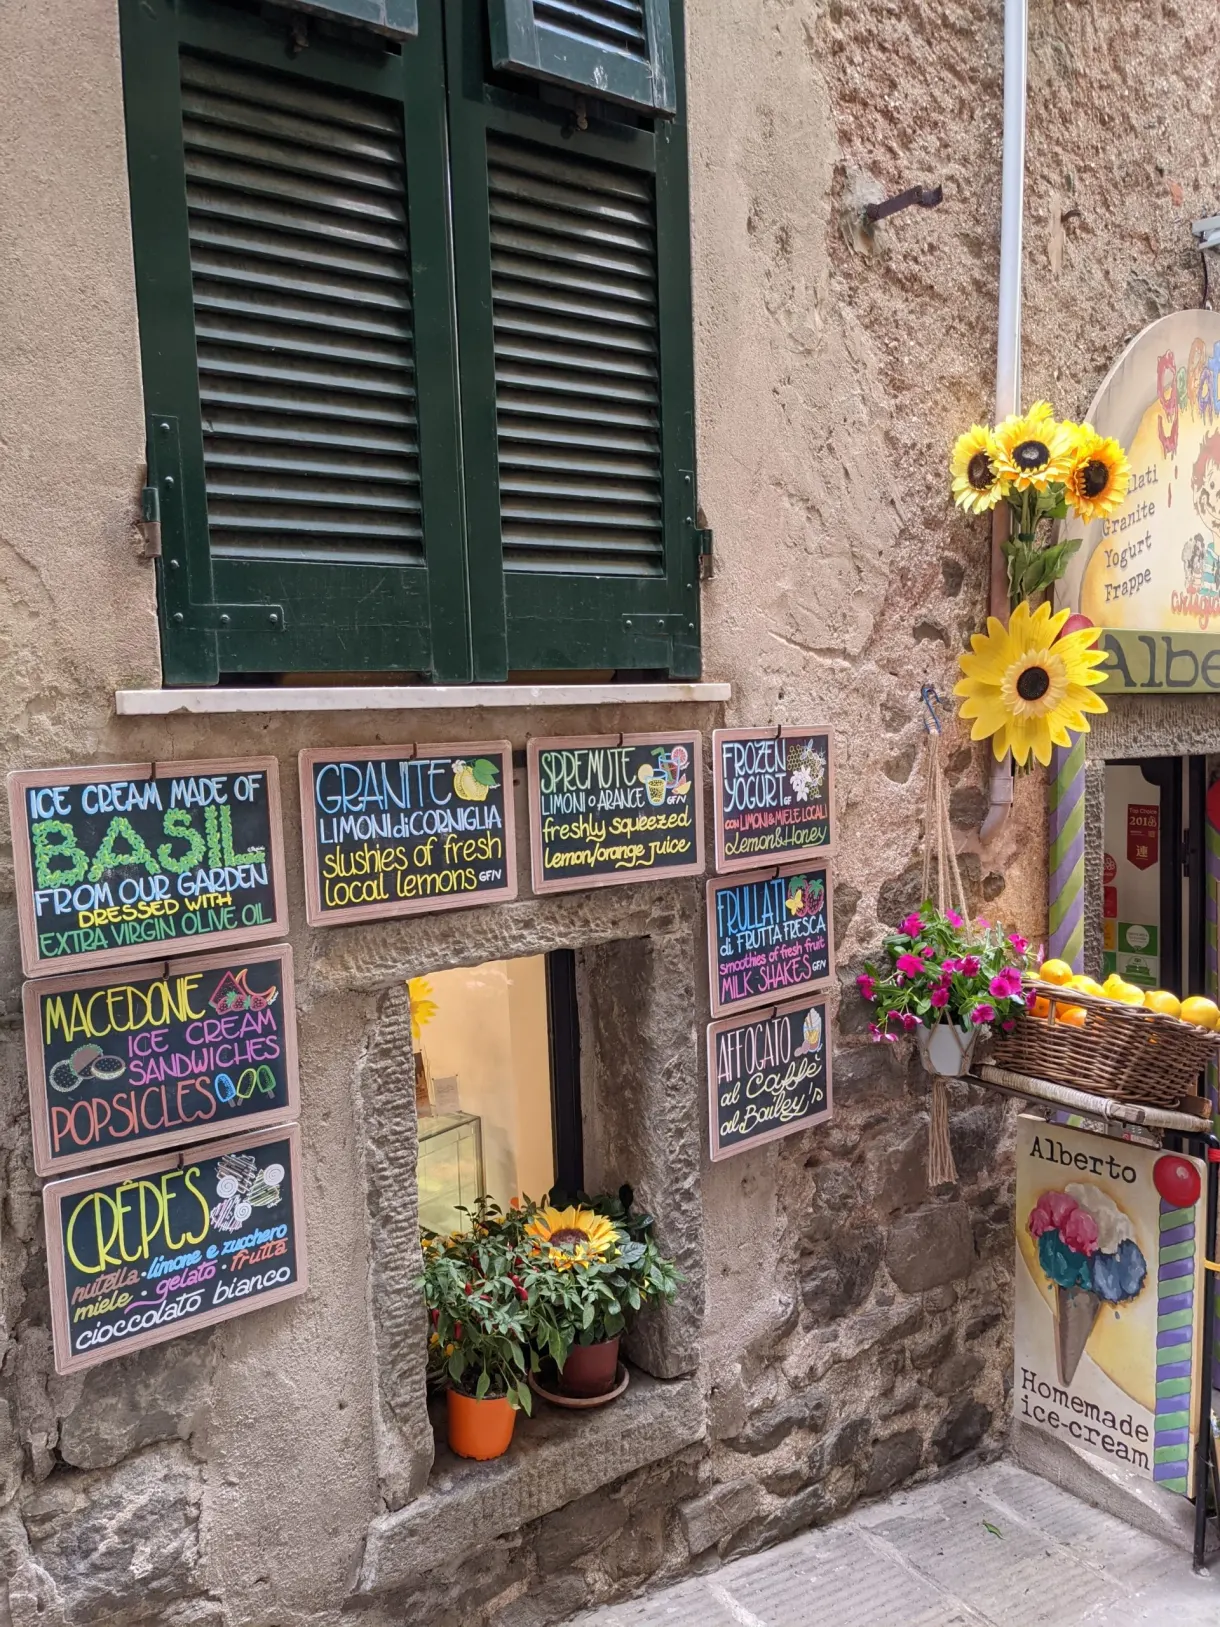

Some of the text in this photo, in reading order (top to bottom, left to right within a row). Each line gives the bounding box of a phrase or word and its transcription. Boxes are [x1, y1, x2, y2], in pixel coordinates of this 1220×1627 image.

[1102, 500, 1155, 536] Granite
[1104, 529, 1152, 569] Yogurt
[1104, 568, 1152, 602] Frappe
[541, 748, 636, 793] SPREMUTE
[723, 739, 786, 778] FROZEN
[30, 775, 262, 819] ICE CREAM MADE OF
[316, 759, 452, 813] GRANITE
[542, 792, 585, 815] LIMONI
[597, 788, 645, 811] ARANCE
[724, 774, 792, 812] YOGURT GF
[320, 805, 502, 843] LIMONI di CORNIGLIA
[543, 805, 692, 843] freshly squeezed
[802, 804, 827, 821] LOCALI
[32, 805, 265, 889] BASIL
[323, 831, 502, 878] slushies of fresh
[34, 864, 268, 916] FROM OUR GARDEN
[79, 892, 232, 928] DRESSED WITH
[326, 874, 388, 906] local
[397, 868, 477, 897] lemons
[717, 879, 786, 937] FRULLATI
[39, 903, 271, 957] EXTRA VIRGIN OLIVE OIL
[720, 914, 826, 956] di FRUTTA FRESCA
[719, 936, 825, 975] smoothies of fresh fruit
[722, 970, 754, 1003] MILK
[758, 955, 811, 991] SHAKES
[46, 974, 205, 1045] MACEDONIE
[128, 1011, 277, 1057] ICE CREAM
[718, 1016, 790, 1085] AFFOGATO
[129, 1037, 280, 1085] SANDWICHES
[52, 1076, 217, 1152] POPSICLES
[721, 1082, 740, 1107] al
[721, 1110, 739, 1136] al
[1029, 1136, 1137, 1183] Alberto
[67, 1167, 210, 1274] CRÊPES
[71, 1224, 287, 1304] nutella limone e zucchero
[74, 1238, 288, 1324] miele gelato frutta
[76, 1267, 291, 1350] cioccolato bianco
[1021, 1367, 1149, 1442] Homemade
[1021, 1394, 1150, 1471] ice-cream
